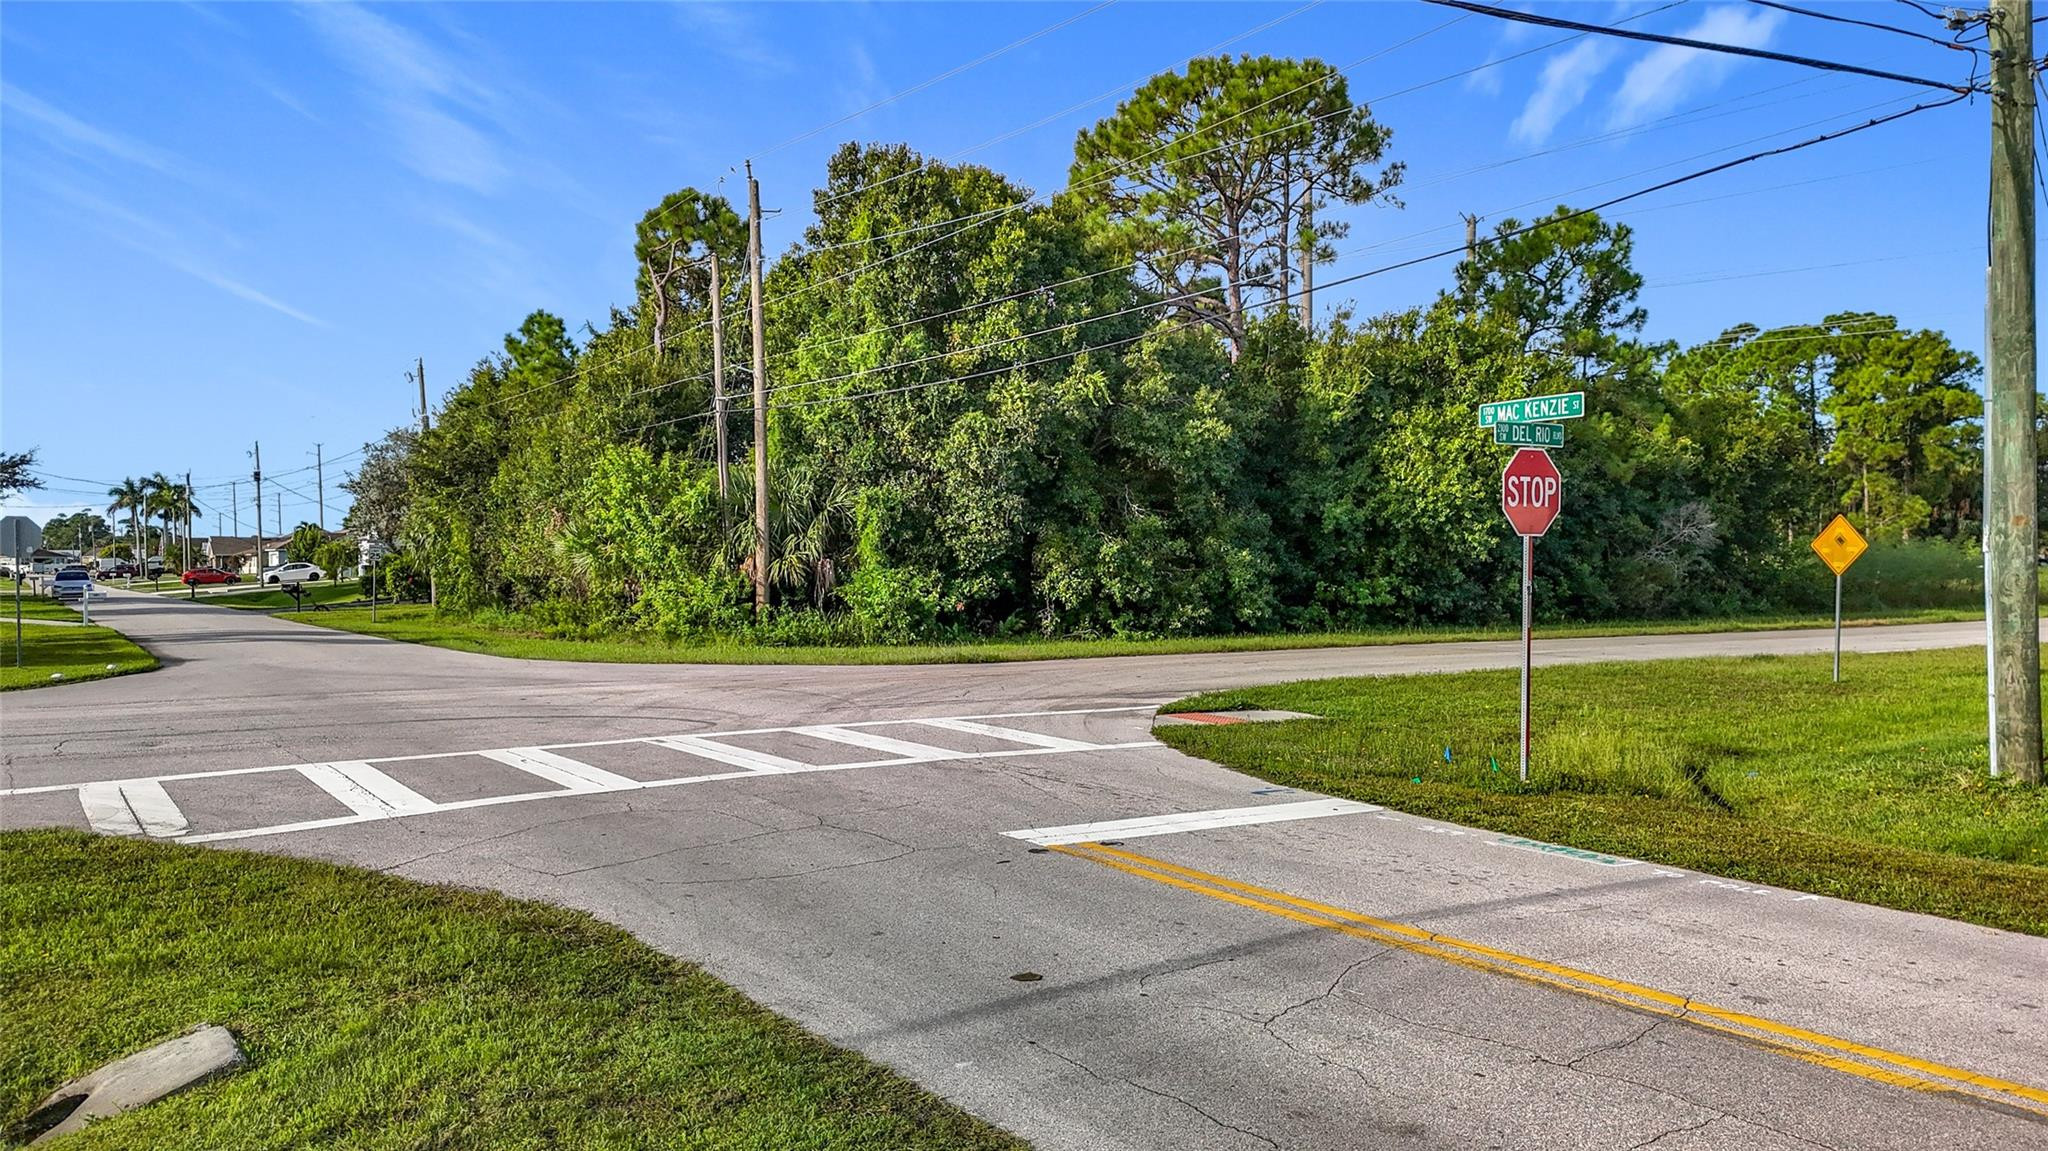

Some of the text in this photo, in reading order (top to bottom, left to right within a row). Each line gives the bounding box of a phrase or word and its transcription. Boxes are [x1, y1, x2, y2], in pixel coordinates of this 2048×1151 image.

[1498, 398, 1580, 420] MAC KENZIE ST
[1512, 426, 1532, 442] DEL
[1536, 426, 1550, 444] RIO
[1507, 475, 1557, 508] STOP
